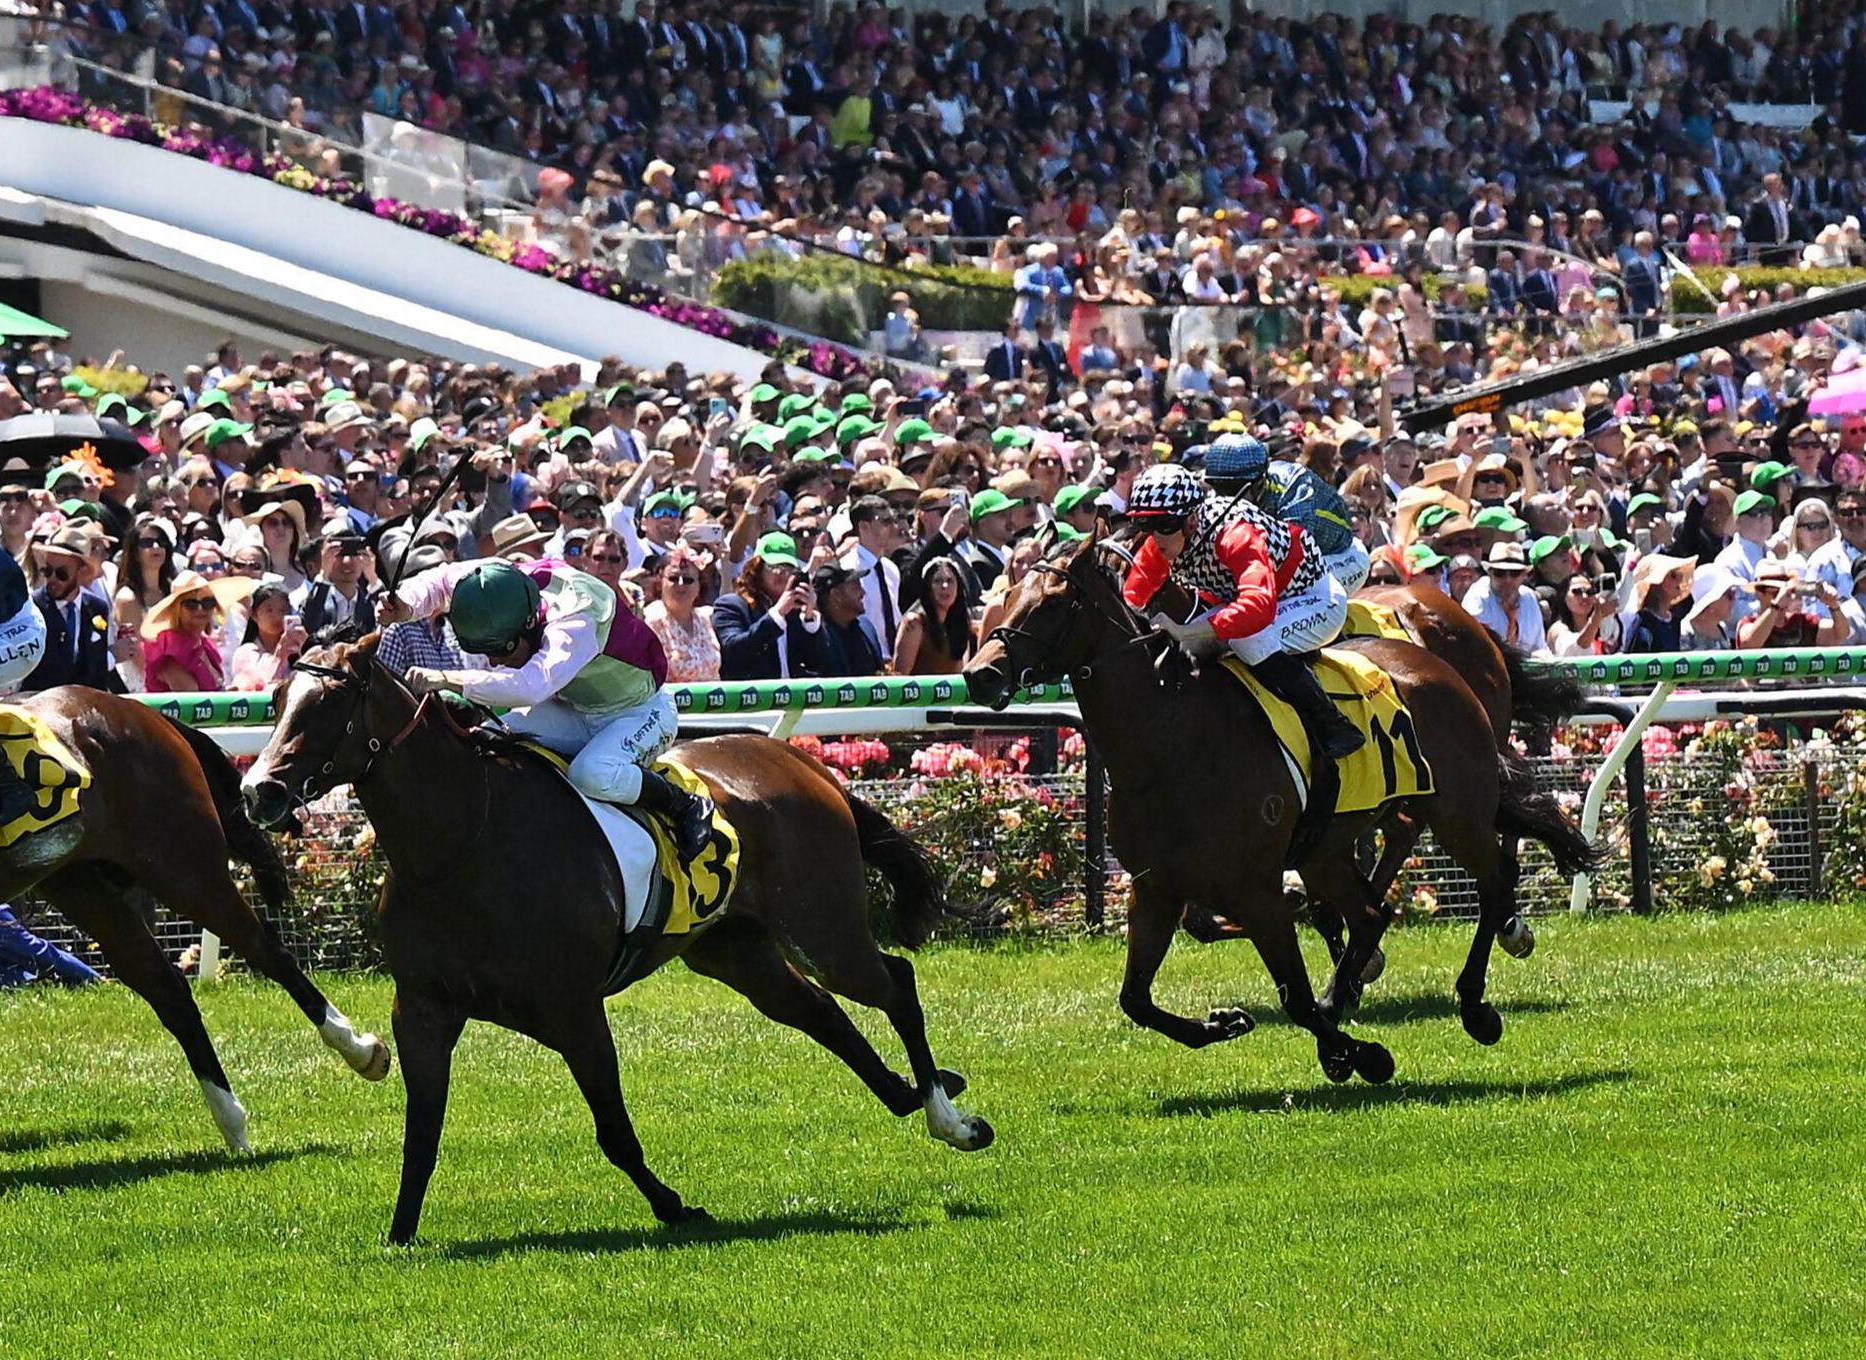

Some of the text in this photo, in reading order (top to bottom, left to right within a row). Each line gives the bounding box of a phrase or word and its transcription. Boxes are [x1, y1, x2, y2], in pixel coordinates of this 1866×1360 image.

[676, 695, 690, 705] TAB
[709, 695, 723, 705] TAB
[742, 694, 756, 704] TAB
[775, 693, 789, 703] TAB
[808, 692, 822, 702] TAB
[840, 690, 854, 700] TAB
[873, 689, 886, 699] TAB
[905, 688, 918, 698] TAB
[936, 687, 950, 697] TAB
[196, 708, 211, 718] TAB
[232, 707, 247, 717] TAB
[1370, 709, 1431, 797] 11
